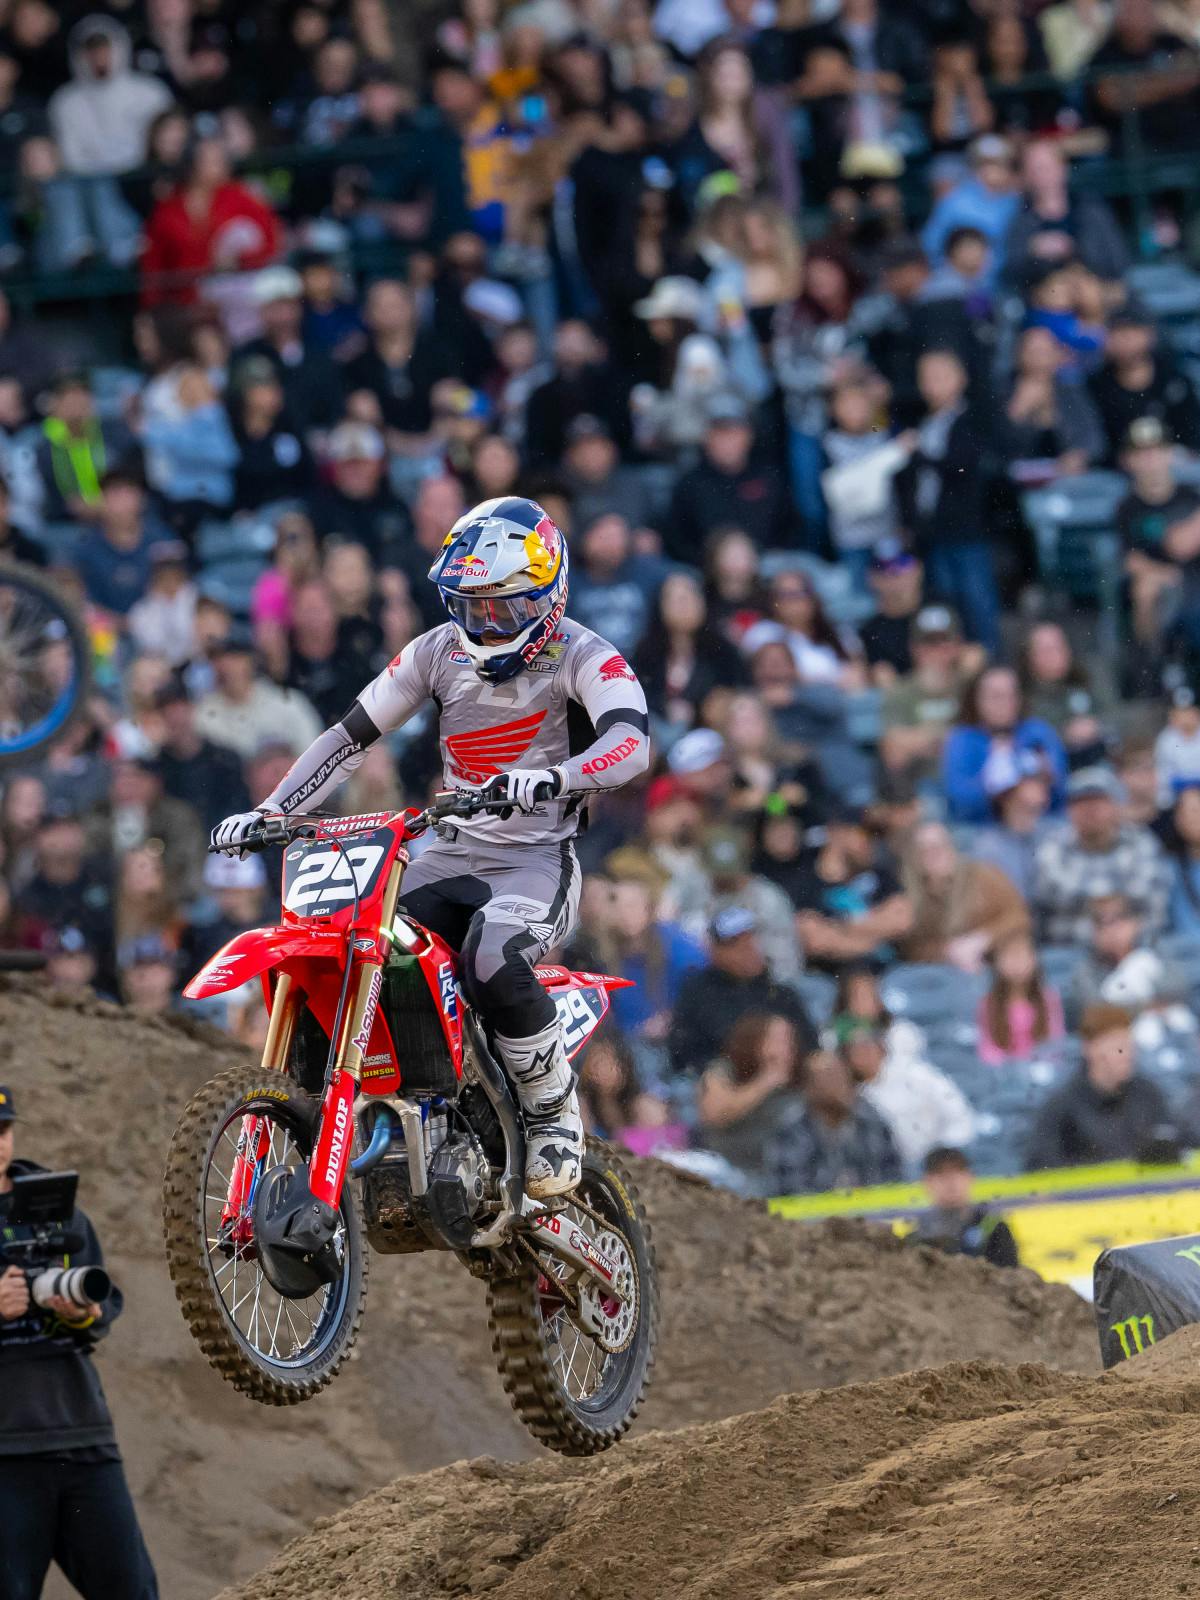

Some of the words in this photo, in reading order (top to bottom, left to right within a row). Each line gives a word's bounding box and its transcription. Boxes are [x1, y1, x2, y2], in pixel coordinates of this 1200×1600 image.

[442, 568, 465, 577] Red
[465, 567, 489, 578] Bull
[520, 618, 555, 664] Red
[526, 661, 560, 674] WPS
[581, 736, 640, 775] HONDA
[321, 821, 383, 834] RENTHAL
[286, 845, 385, 911] 29
[439, 961, 457, 1015] CRF
[553, 989, 599, 1049] 29
[362, 1067, 395, 1078] HINSON
[325, 1098, 350, 1187] DUNLOP
